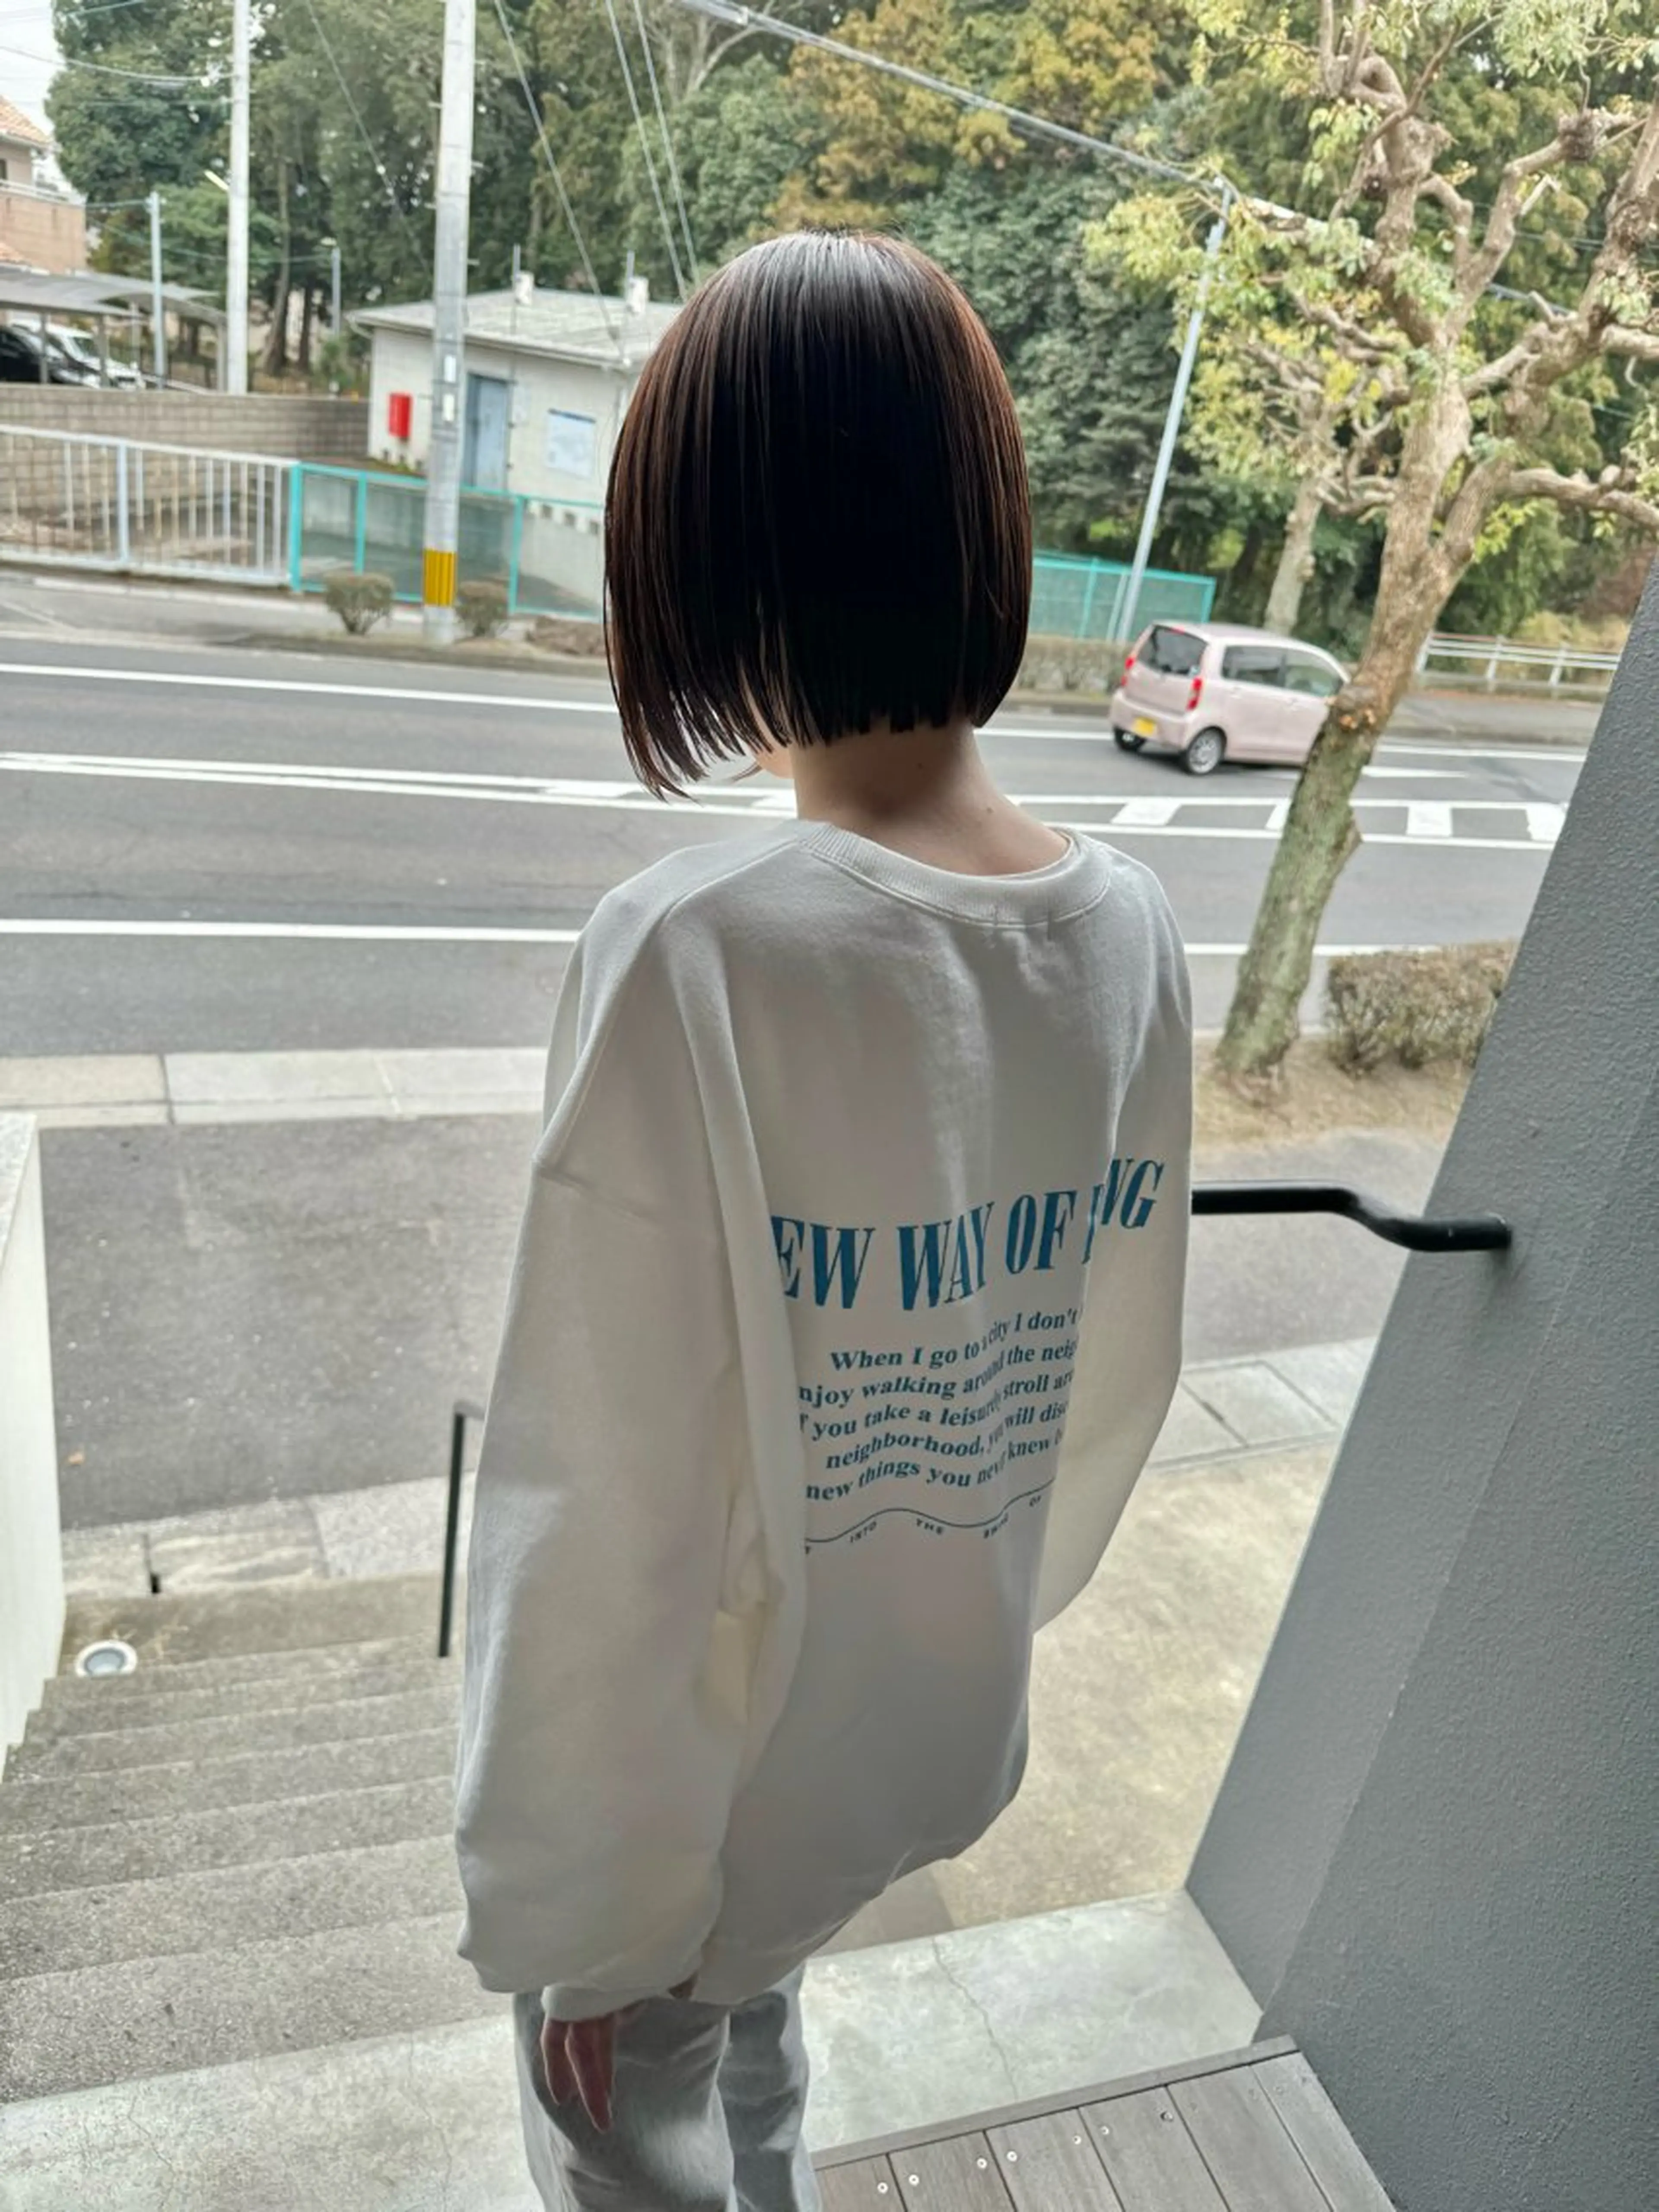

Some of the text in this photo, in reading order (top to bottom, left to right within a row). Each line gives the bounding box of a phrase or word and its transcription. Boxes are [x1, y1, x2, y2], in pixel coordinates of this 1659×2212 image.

[896, 1202, 995, 1311] WAY
[1005, 1190, 1077, 1275] OF
[830, 1349, 903, 1371] When
[912, 1346, 924, 1365] I
[929, 1349, 958, 1370] go
[964, 1341, 980, 1360] to
[1014, 1312, 1022, 1332] I
[1027, 1307, 1078, 1331] don't
[862, 1376, 957, 1401] walking
[1007, 1344, 1036, 1366] the
[812, 1419, 857, 1442] you
[864, 1404, 911, 1428] take
[918, 1408, 932, 1423] a
[1003, 1373, 1050, 1401] stroll
[806, 1481, 854, 1500] new
[858, 1460, 921, 1488] things
[925, 1467, 972, 1487] you
[1008, 1438, 1050, 1461] knew
